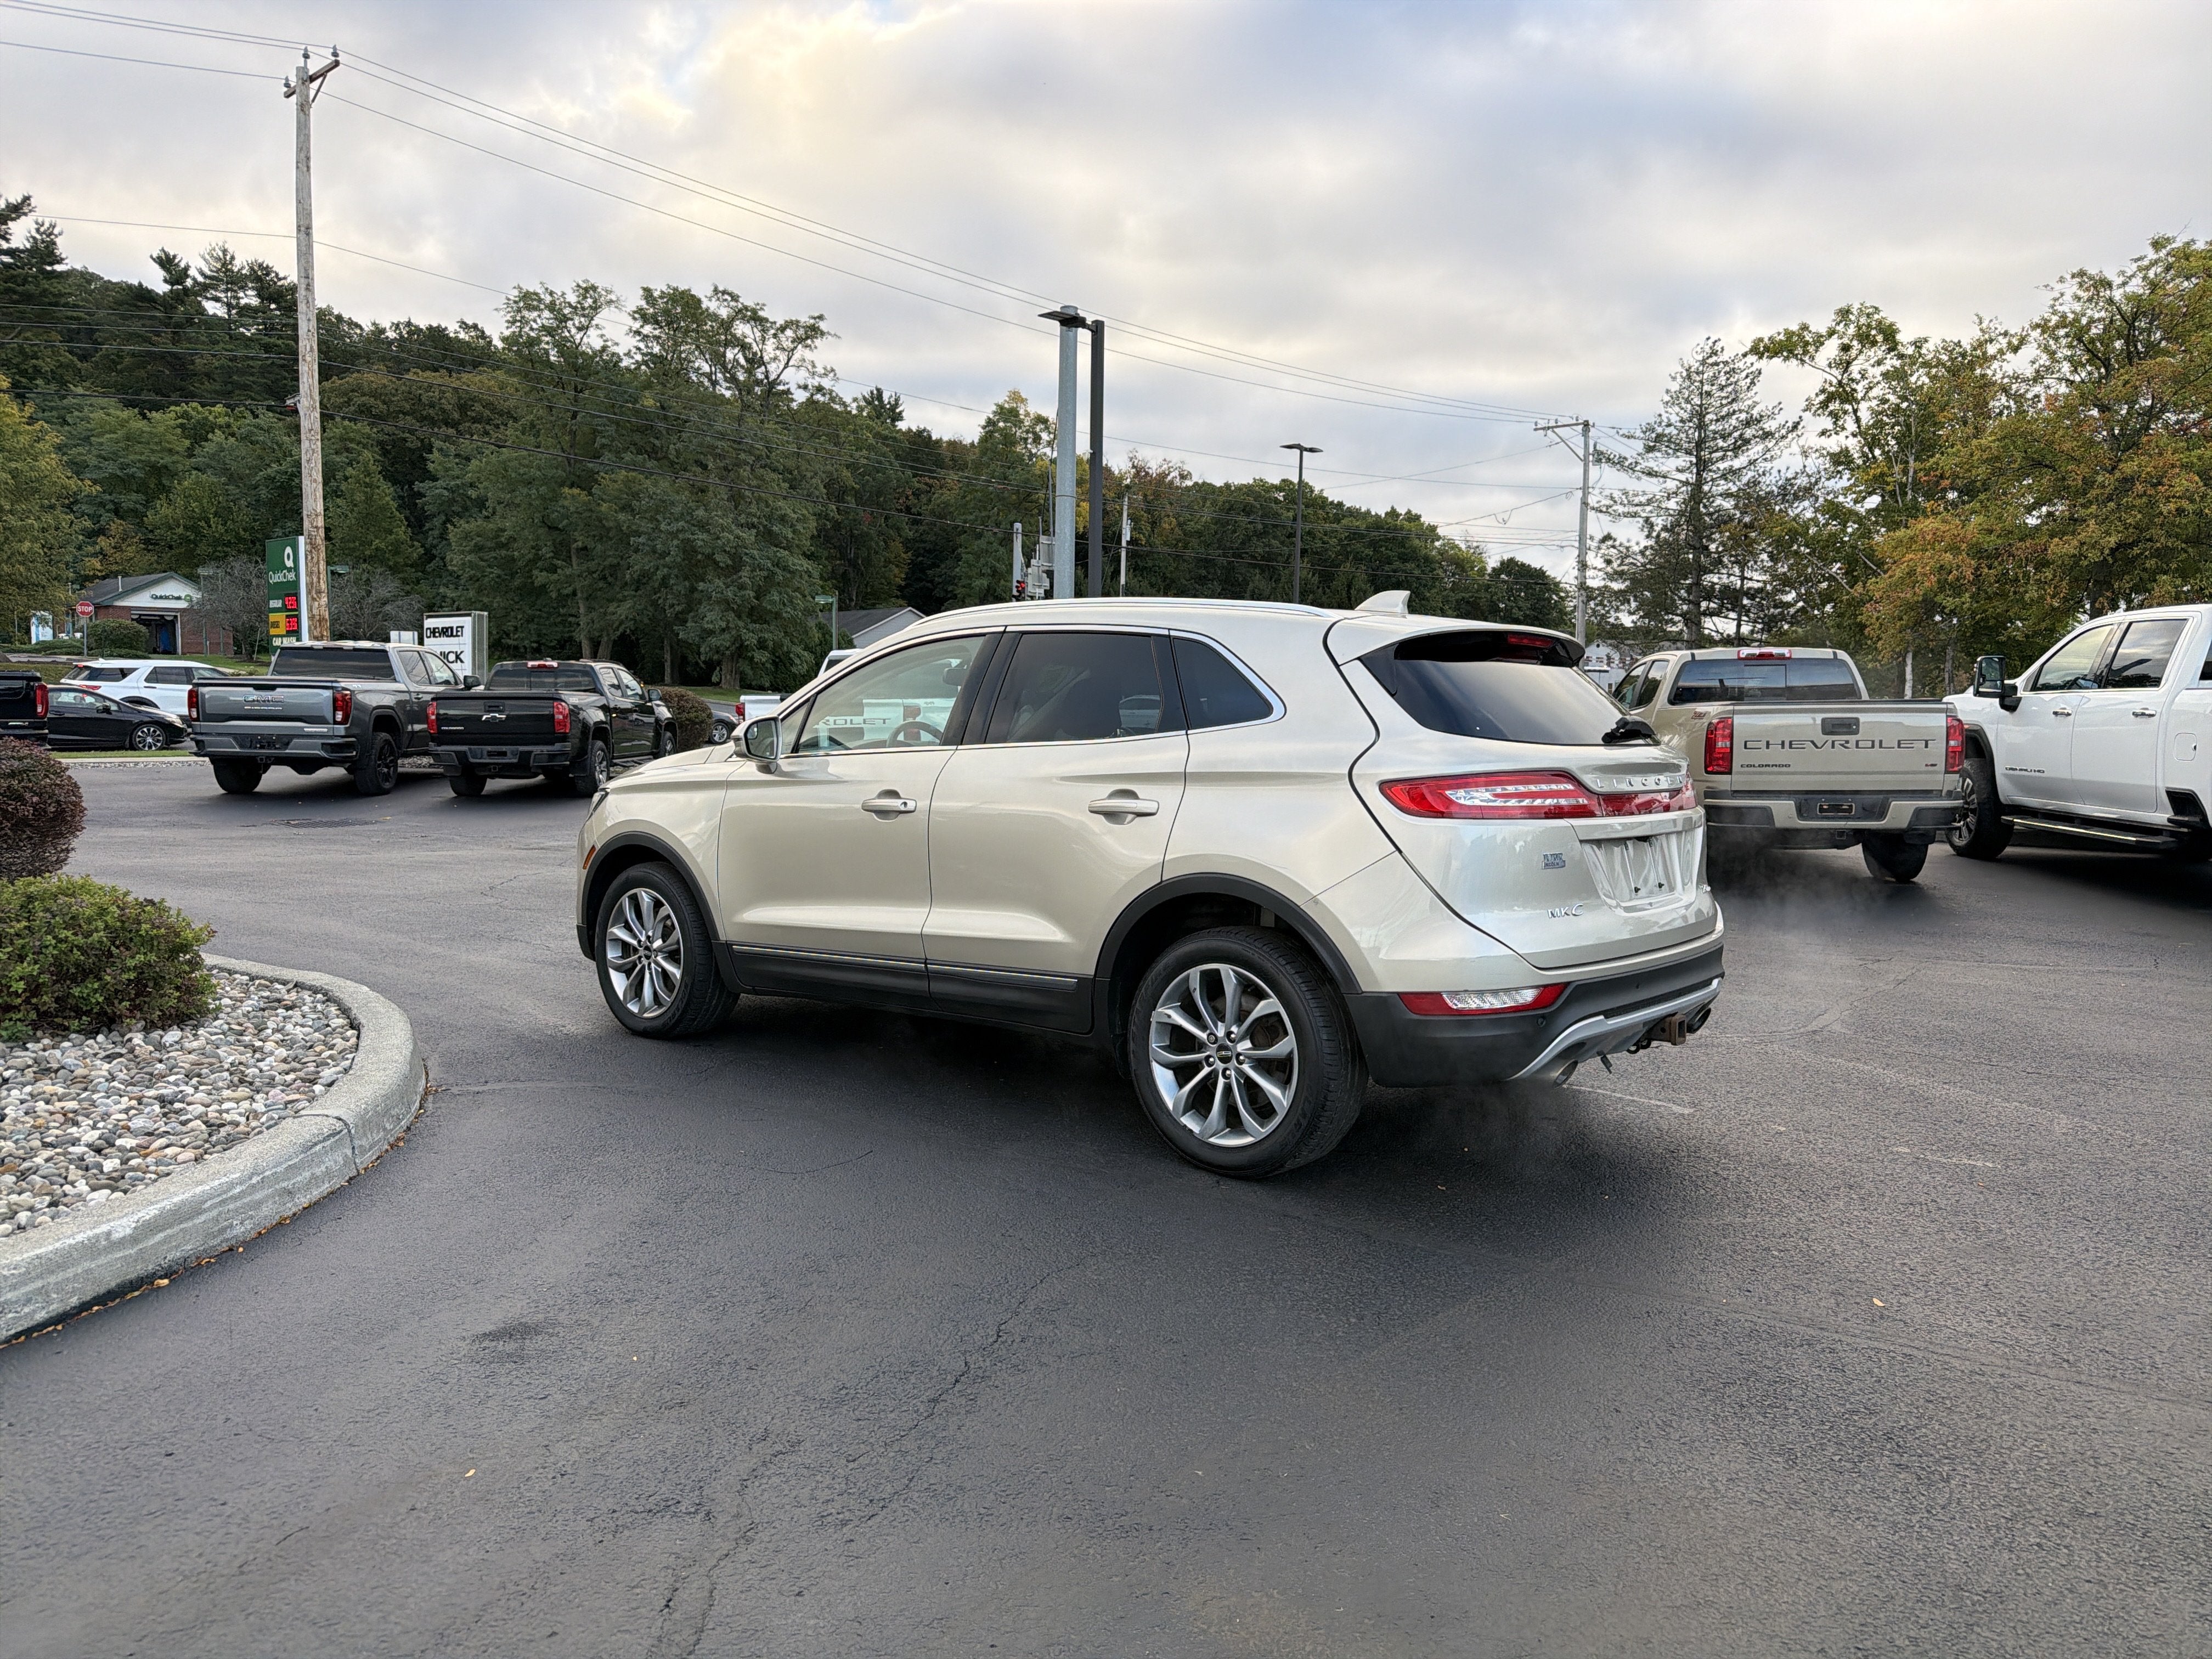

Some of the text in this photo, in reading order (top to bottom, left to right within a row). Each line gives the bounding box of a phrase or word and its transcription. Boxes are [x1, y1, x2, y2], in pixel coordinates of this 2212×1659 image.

[269, 569, 296, 585] QuickChek
[425, 625, 465, 639] CHEVROLET
[273, 637, 281, 646] CAR
[242, 694, 285, 703] GMC
[1743, 739, 1937, 751] CHEVROLET
[1596, 775, 1683, 789] LINCOLN
[1547, 903, 1584, 919] MKC
